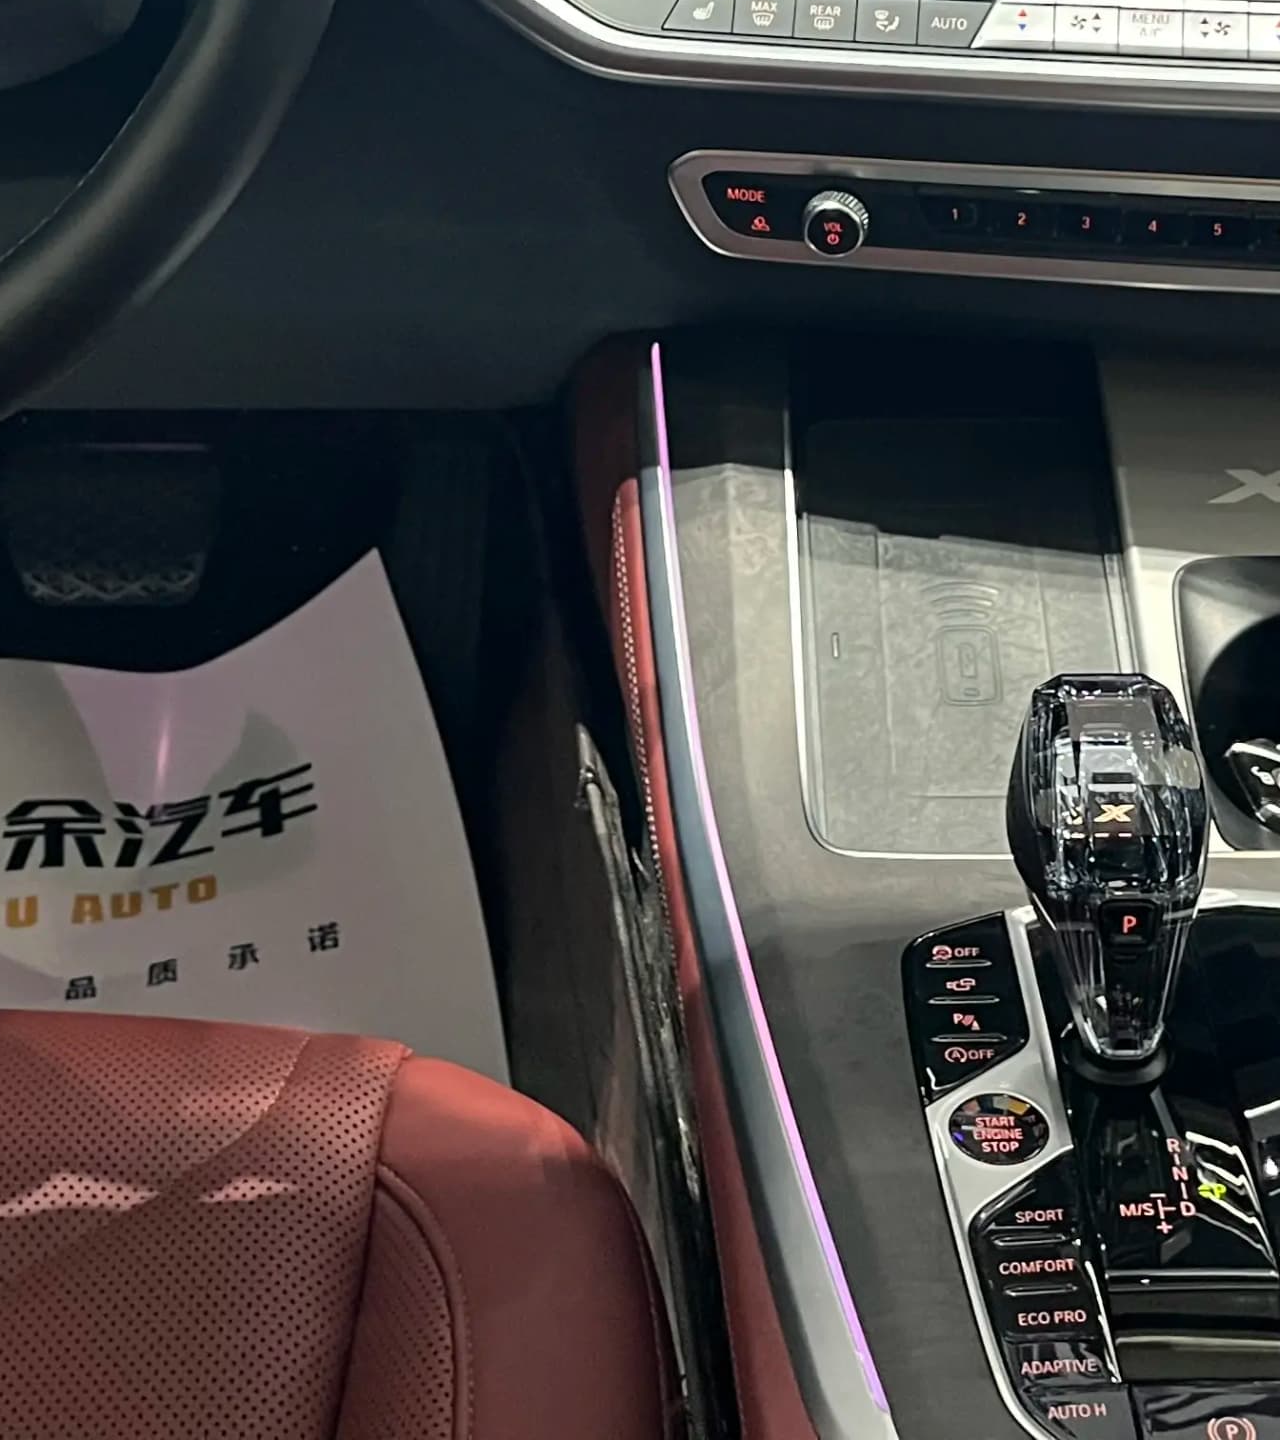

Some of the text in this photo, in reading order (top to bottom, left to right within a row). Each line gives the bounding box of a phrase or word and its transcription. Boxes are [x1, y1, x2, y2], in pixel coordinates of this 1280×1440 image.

[751, 0, 778, 12] MAX
[809, 4, 841, 17] REAR
[931, 17, 968, 31] AUTO
[1132, 13, 1170, 25] MENU
[727, 188, 766, 202] MODE
[952, 208, 958, 221] 1
[1017, 212, 1026, 225] 2
[823, 222, 843, 233] VOL
[1082, 216, 1091, 229] 3
[1148, 220, 1157, 233] 4
[1213, 224, 1222, 236] 5
[71, 874, 218, 925] AUTO
[1122, 916, 1136, 933] P
[954, 946, 980, 957] OFF
[65, 921, 342, 1001] 品质承诺
[968, 1049, 995, 1060] OFF
[975, 1117, 1016, 1128] START
[973, 1128, 1023, 1140] ENGINE
[982, 1141, 1020, 1153] STOP
[1166, 1138, 1180, 1153] R
[1172, 1166, 1188, 1181] N
[1015, 1208, 1064, 1223] SPORT
[1120, 1201, 1196, 1217] M/S D
[999, 1258, 1076, 1275] COMFORT
[1017, 1310, 1087, 1326] ECO PRO
[1021, 1359, 1098, 1375] ADAPTIVE
[1048, 1403, 1107, 1420] AUTO H
